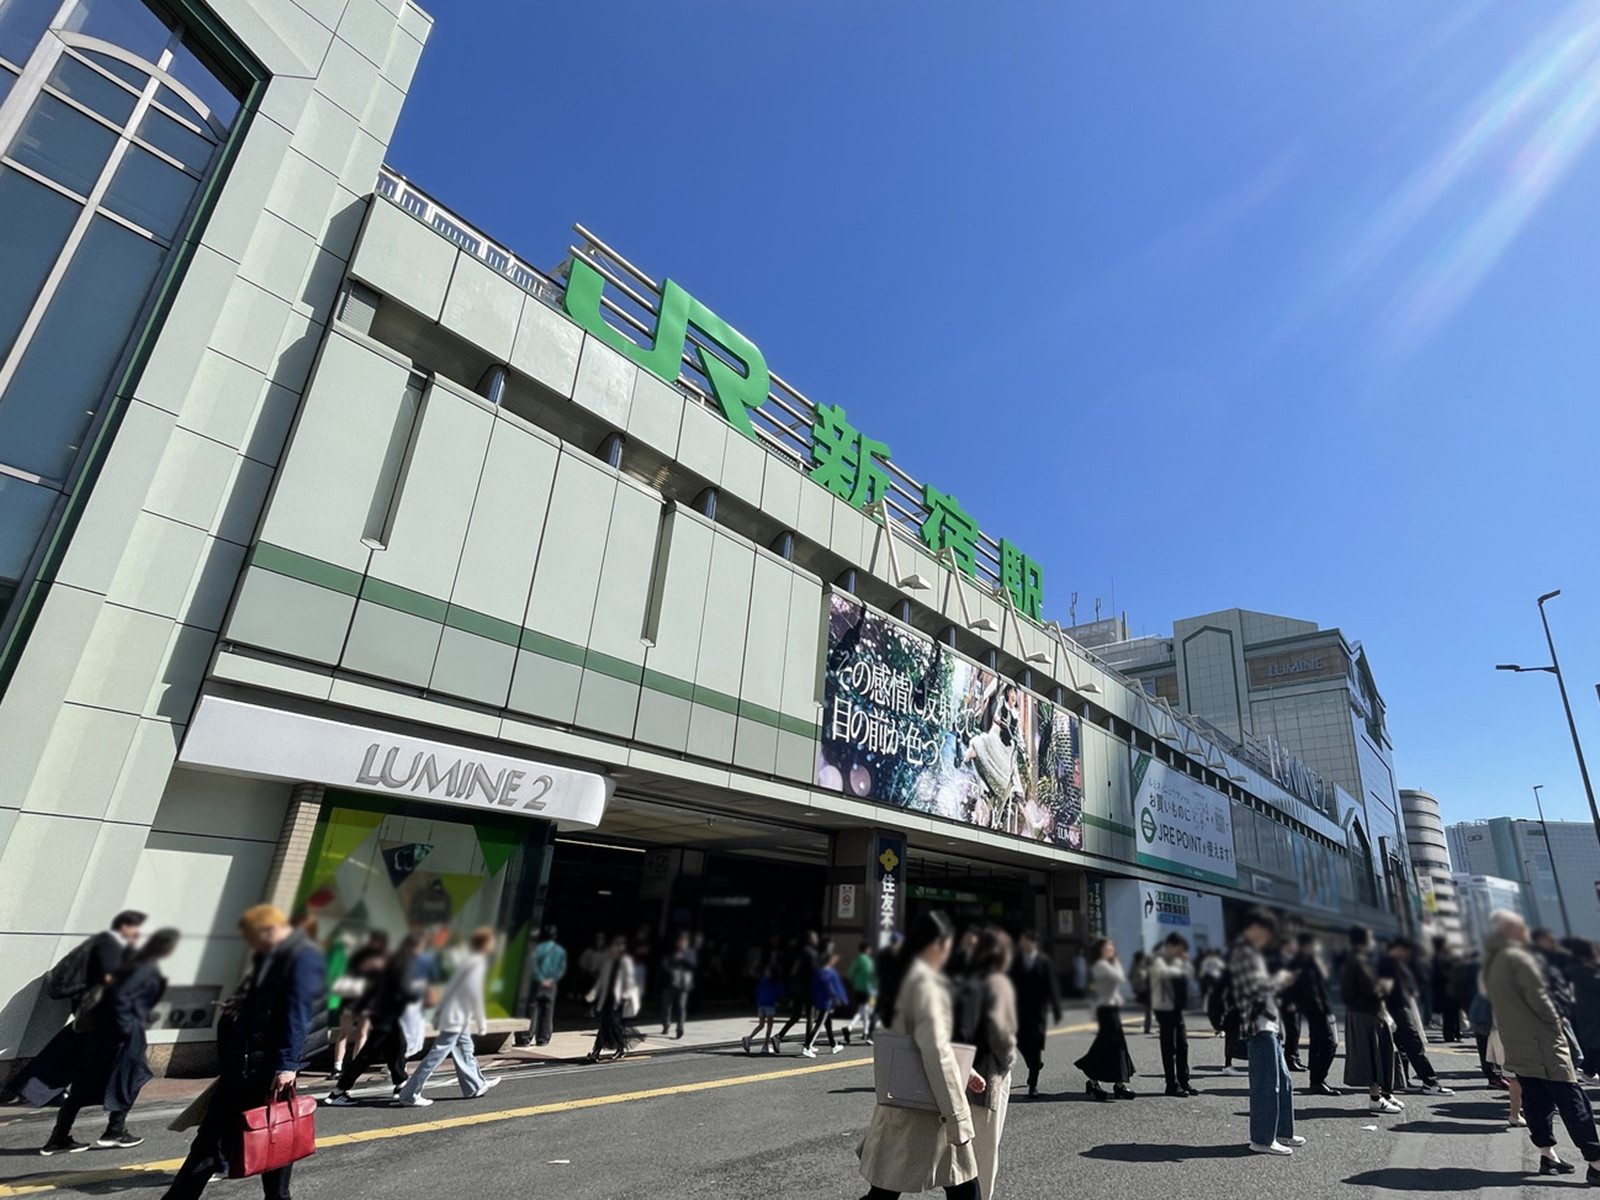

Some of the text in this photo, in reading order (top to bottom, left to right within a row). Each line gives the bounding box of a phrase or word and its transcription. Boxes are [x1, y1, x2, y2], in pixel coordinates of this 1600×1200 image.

[563, 258, 1044, 623] JR 新宿駅
[1268, 656, 1324, 677] LUMINE
[356, 743, 554, 811] LUMINE 2
[1158, 824, 1175, 845] JRE
[880, 873, 896, 949] 住友不
